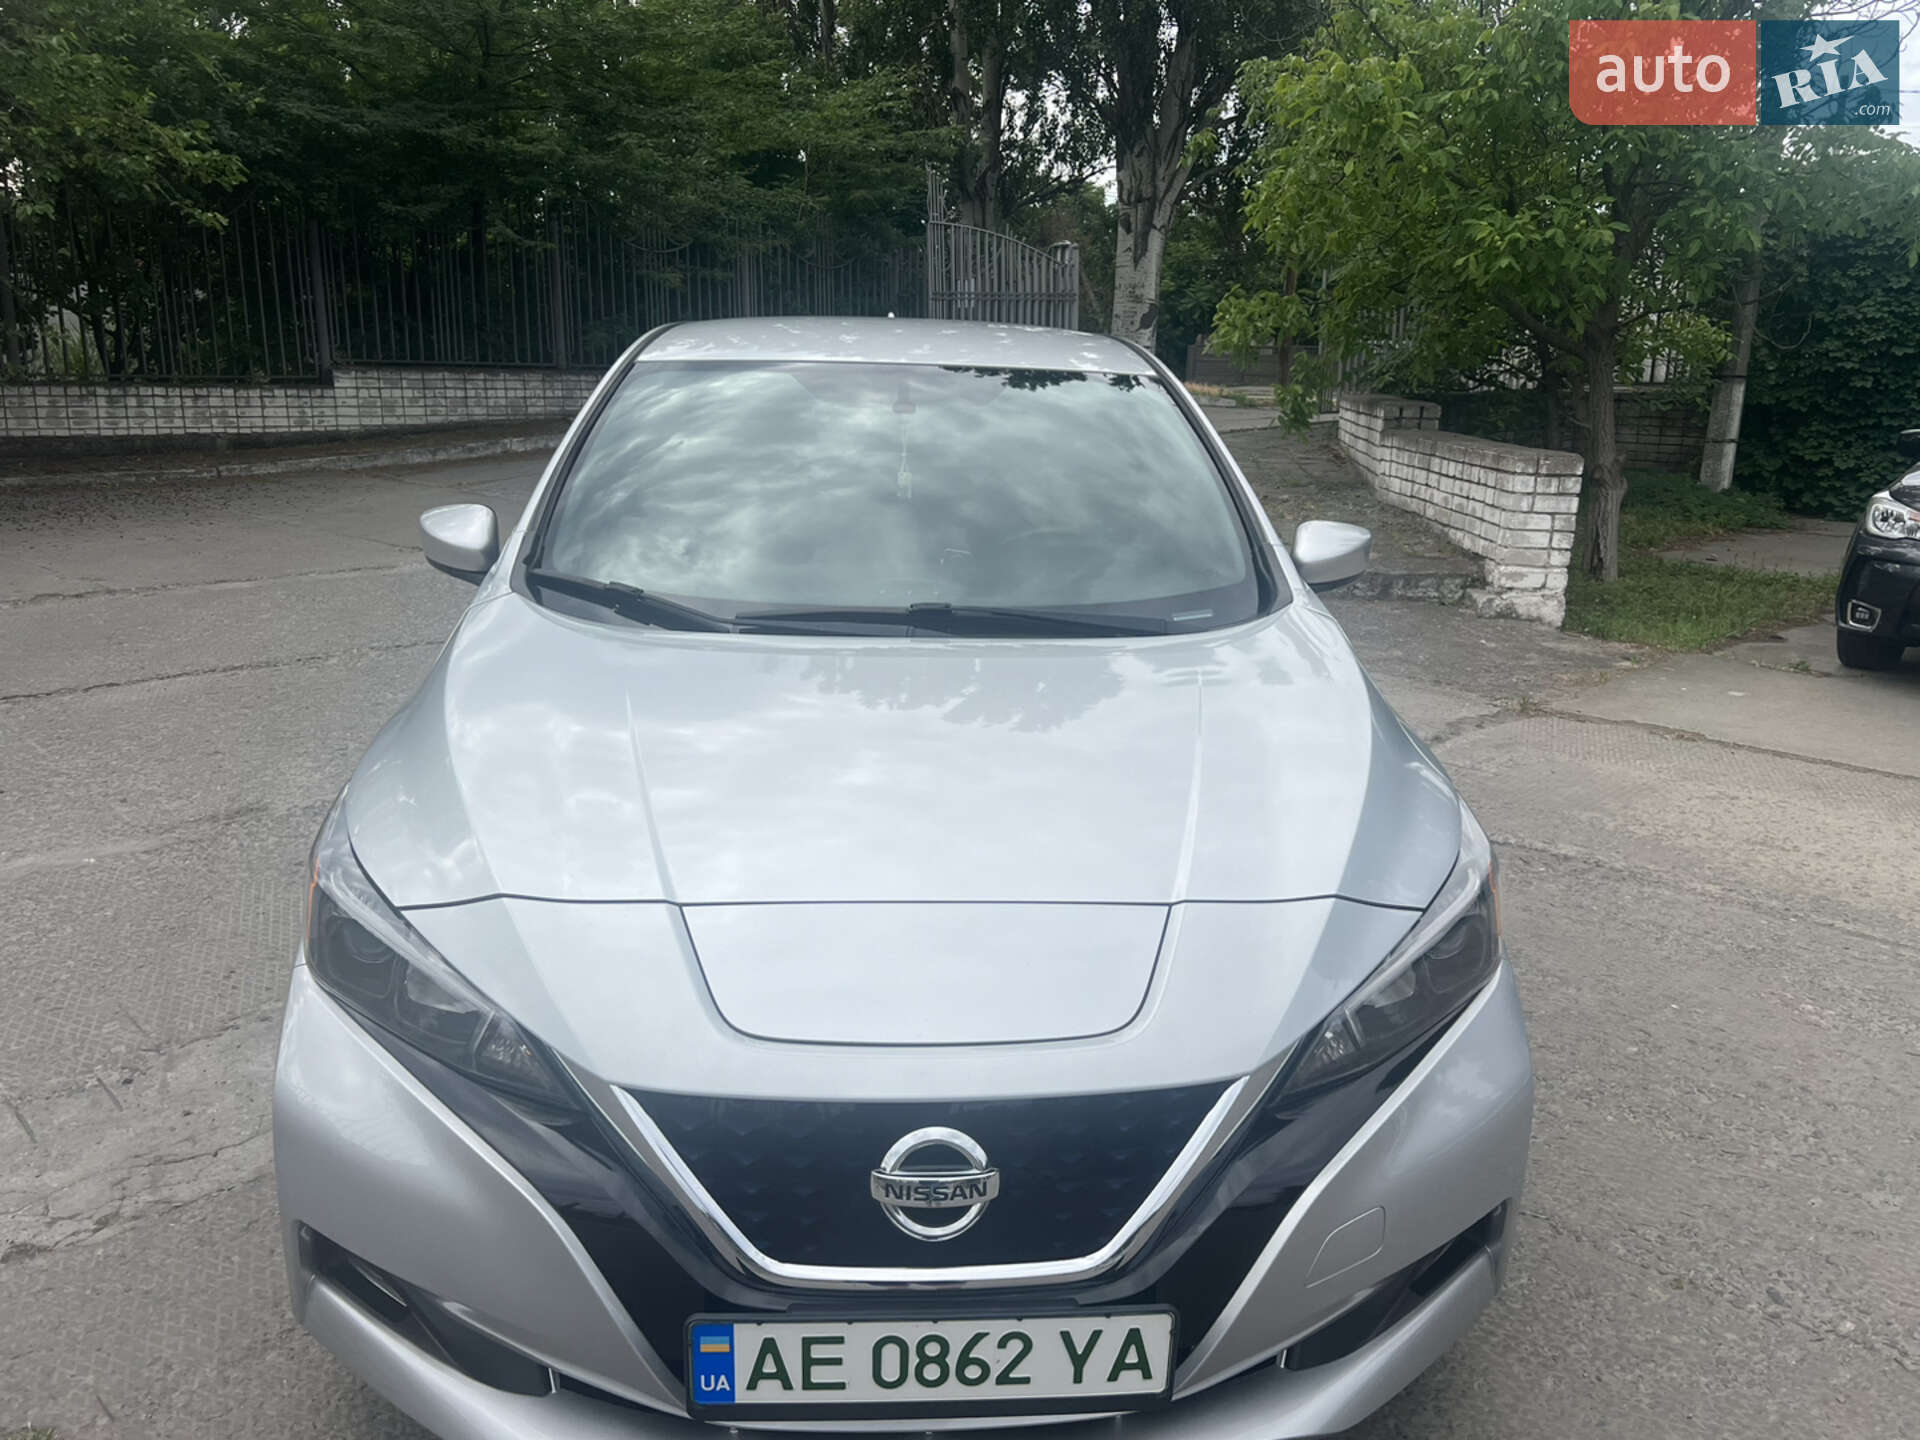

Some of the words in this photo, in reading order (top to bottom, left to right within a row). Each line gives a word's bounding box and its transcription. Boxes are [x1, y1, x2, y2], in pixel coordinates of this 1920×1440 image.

[884, 1181, 988, 1202] NISSAN
[745, 1335, 847, 1391] AE
[871, 1330, 1034, 1389] 0862
[1059, 1327, 1154, 1385] YA
[700, 1374, 731, 1392] UA
